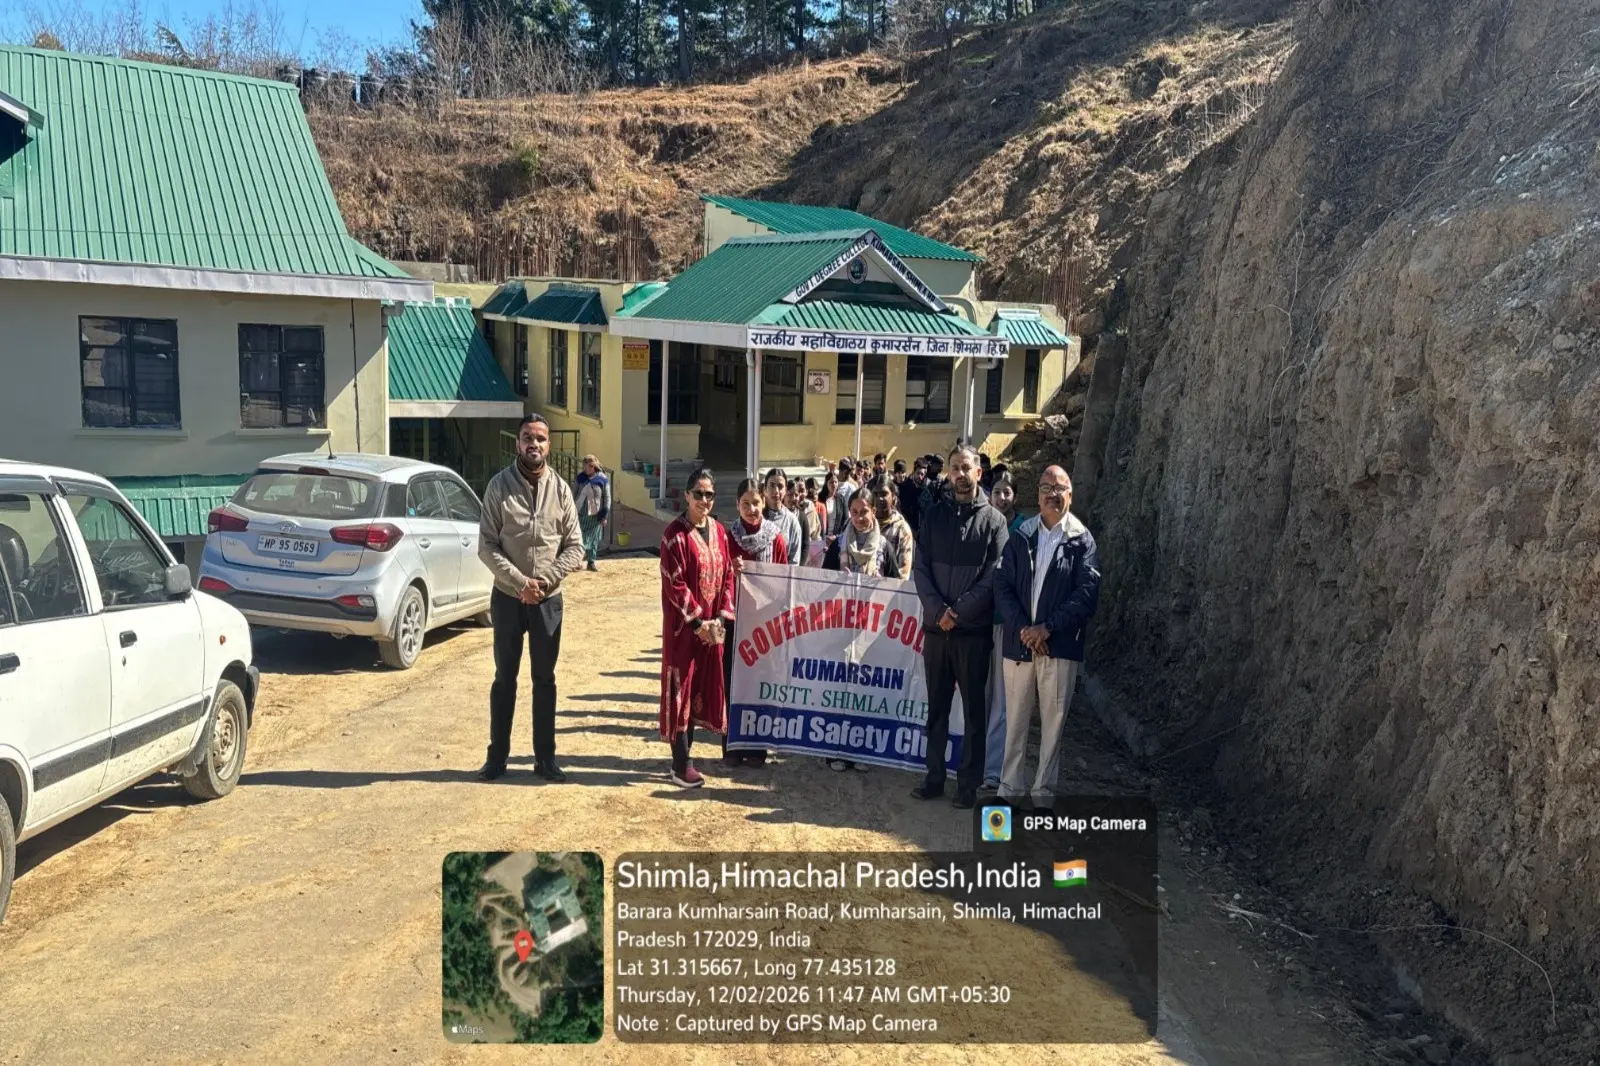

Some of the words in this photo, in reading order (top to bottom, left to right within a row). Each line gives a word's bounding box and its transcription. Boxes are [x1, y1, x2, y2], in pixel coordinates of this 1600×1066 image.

[814, 256, 841, 283] DEGREE
[840, 236, 869, 263] COLLEGE
[871, 236, 906, 276] KUMARSAIN
[906, 270, 928, 295] SHIMLA
[751, 330, 797, 346] राजकीय
[800, 332, 867, 351] महाविद्यालय
[926, 337, 949, 353] जिला
[953, 338, 982, 354] शिमला
[264, 538, 276, 549] HP
[279, 539, 290, 550] 95
[293, 541, 315, 553] 0569
[738, 598, 885, 667] GOVERNMENT
[886, 608, 926, 656] COL
[791, 657, 905, 690] KUMARSAIN
[759, 682, 815, 706] DISTT.
[821, 689, 889, 714] SHIMLA
[739, 710, 804, 740] Road
[808, 715, 890, 754] Safety
